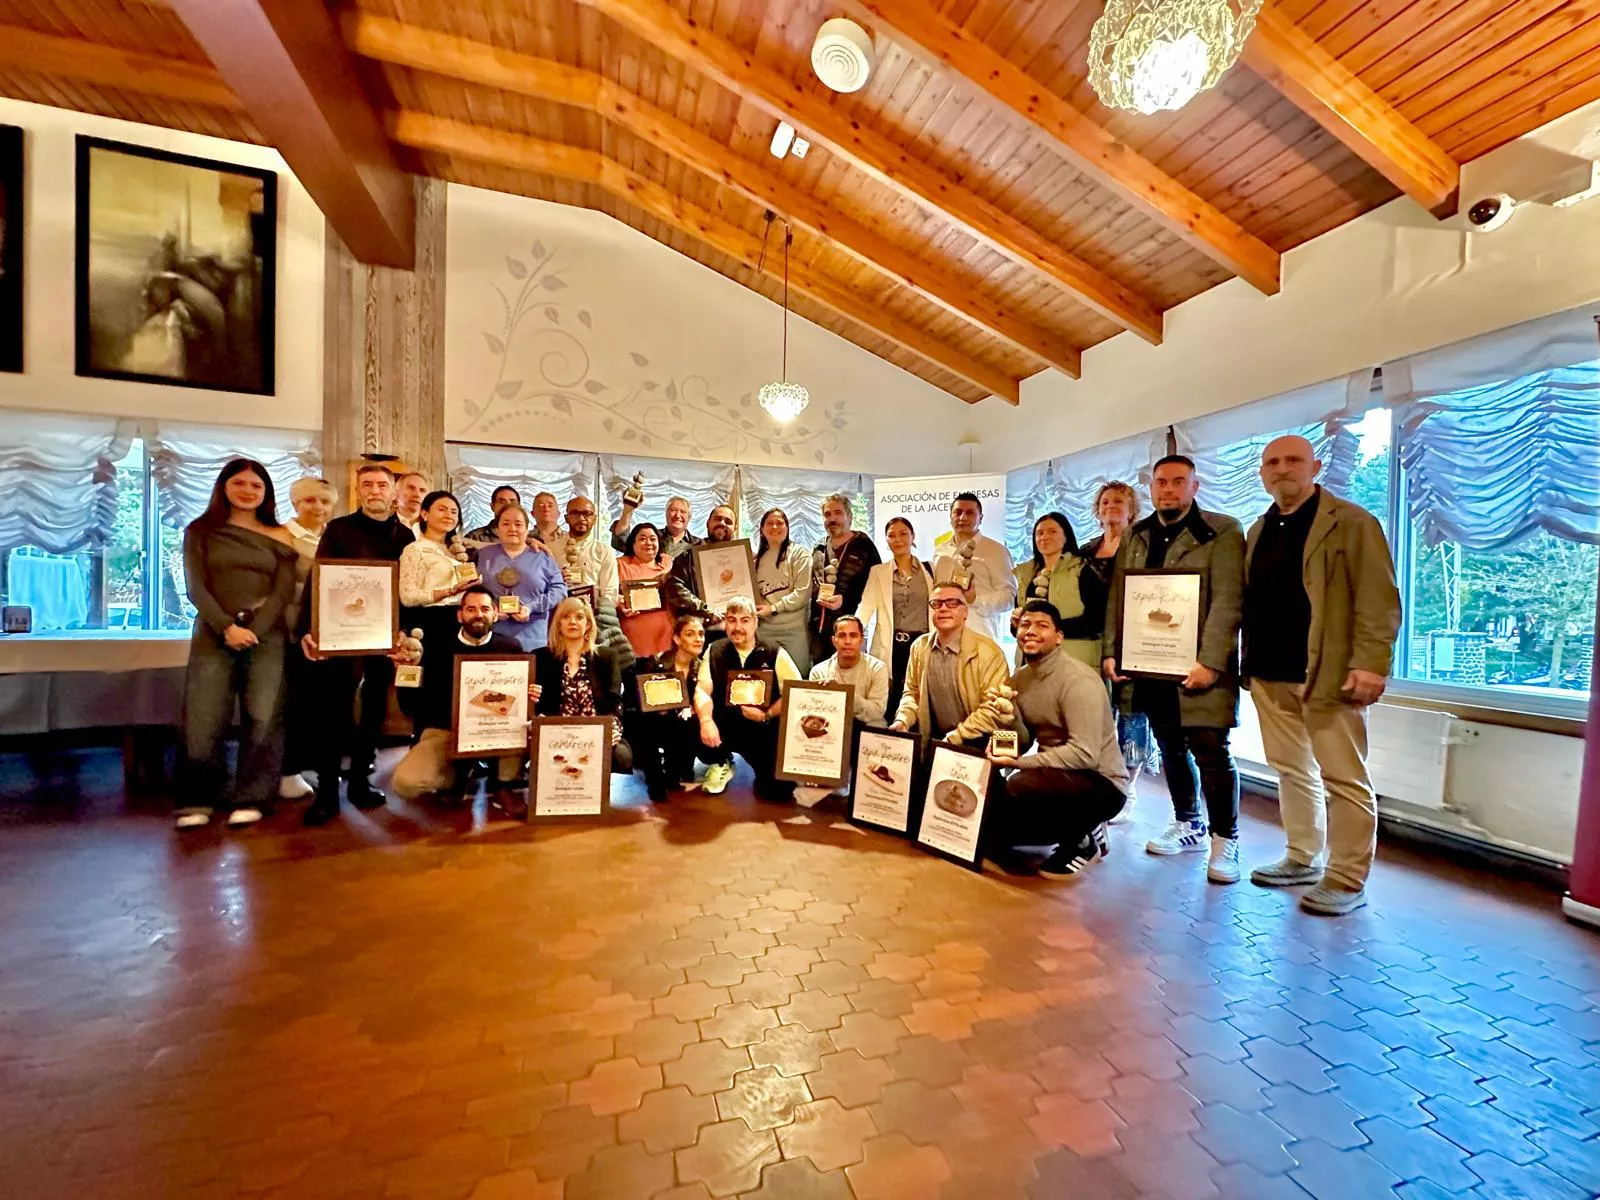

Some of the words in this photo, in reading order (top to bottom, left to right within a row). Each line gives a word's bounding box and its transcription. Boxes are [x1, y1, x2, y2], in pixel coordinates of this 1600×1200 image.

[881, 491, 936, 503] ASOCIACIÓN
[938, 491, 951, 501] DE
[901, 504, 912, 513] DE
[914, 503, 926, 513] LA
